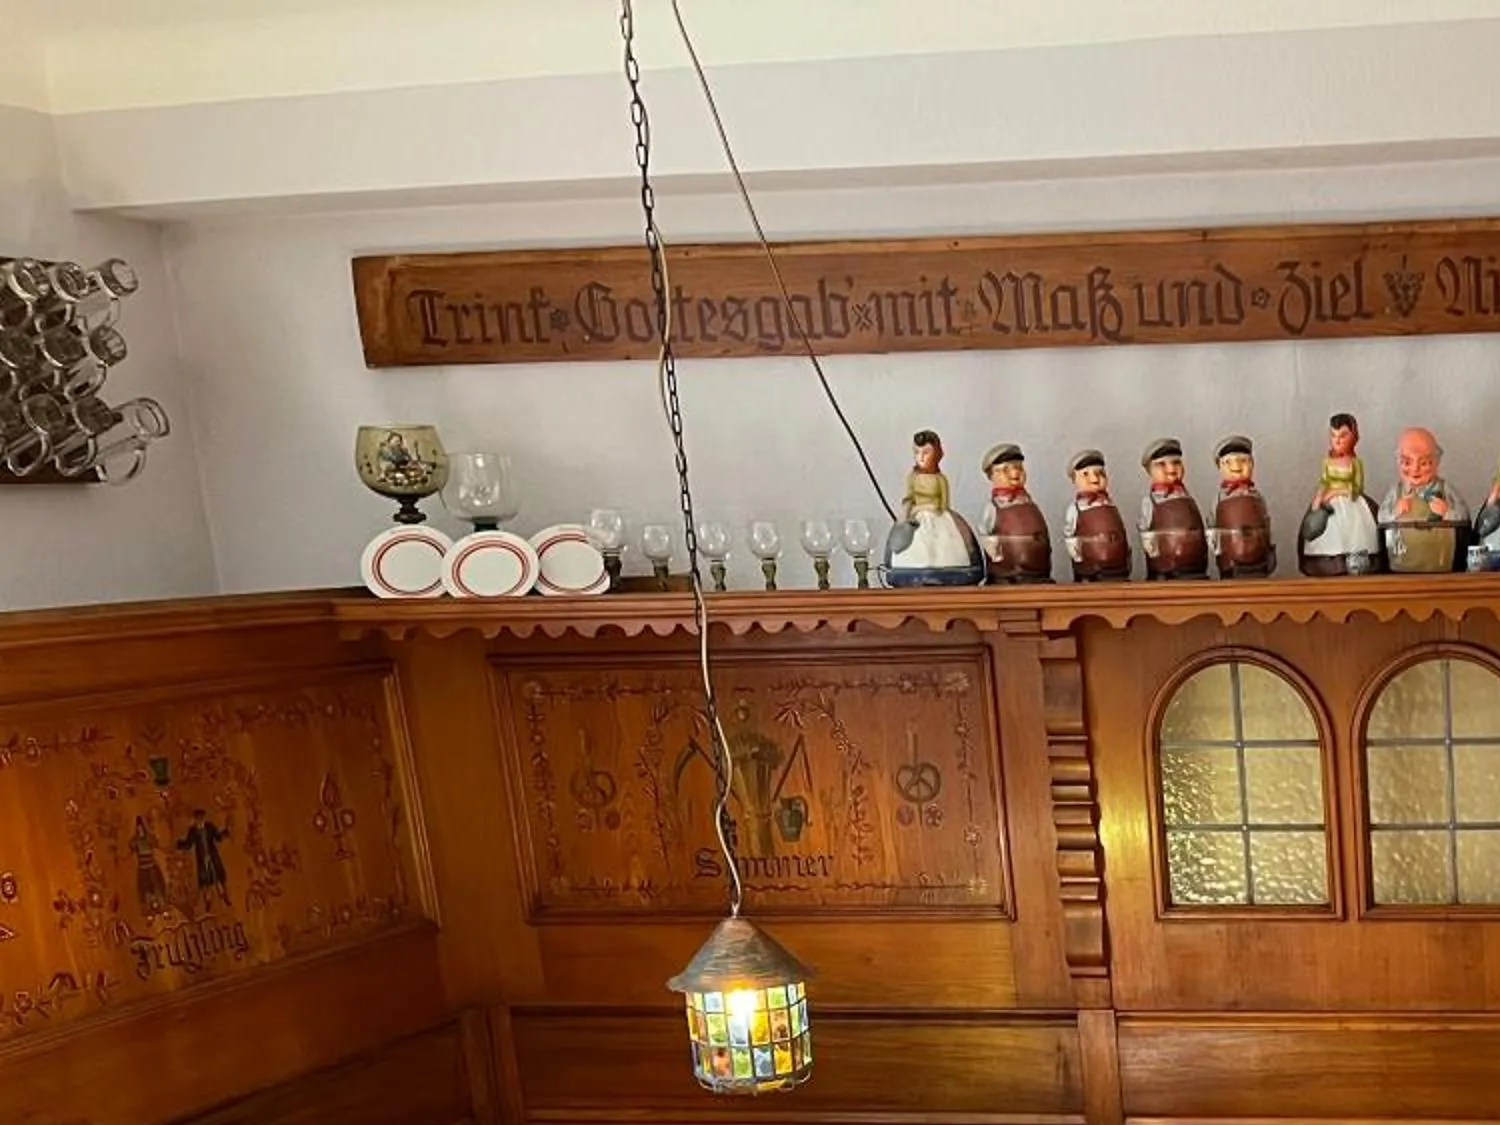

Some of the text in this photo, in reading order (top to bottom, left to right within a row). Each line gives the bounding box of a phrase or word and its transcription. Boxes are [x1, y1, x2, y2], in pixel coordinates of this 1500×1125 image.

[574, 274, 855, 351] Gotesgab'
[868, 275, 958, 337] mit
[1134, 262, 1245, 328] und
[1276, 257, 1375, 336] Ziel
[691, 847, 834, 879] Smmer
